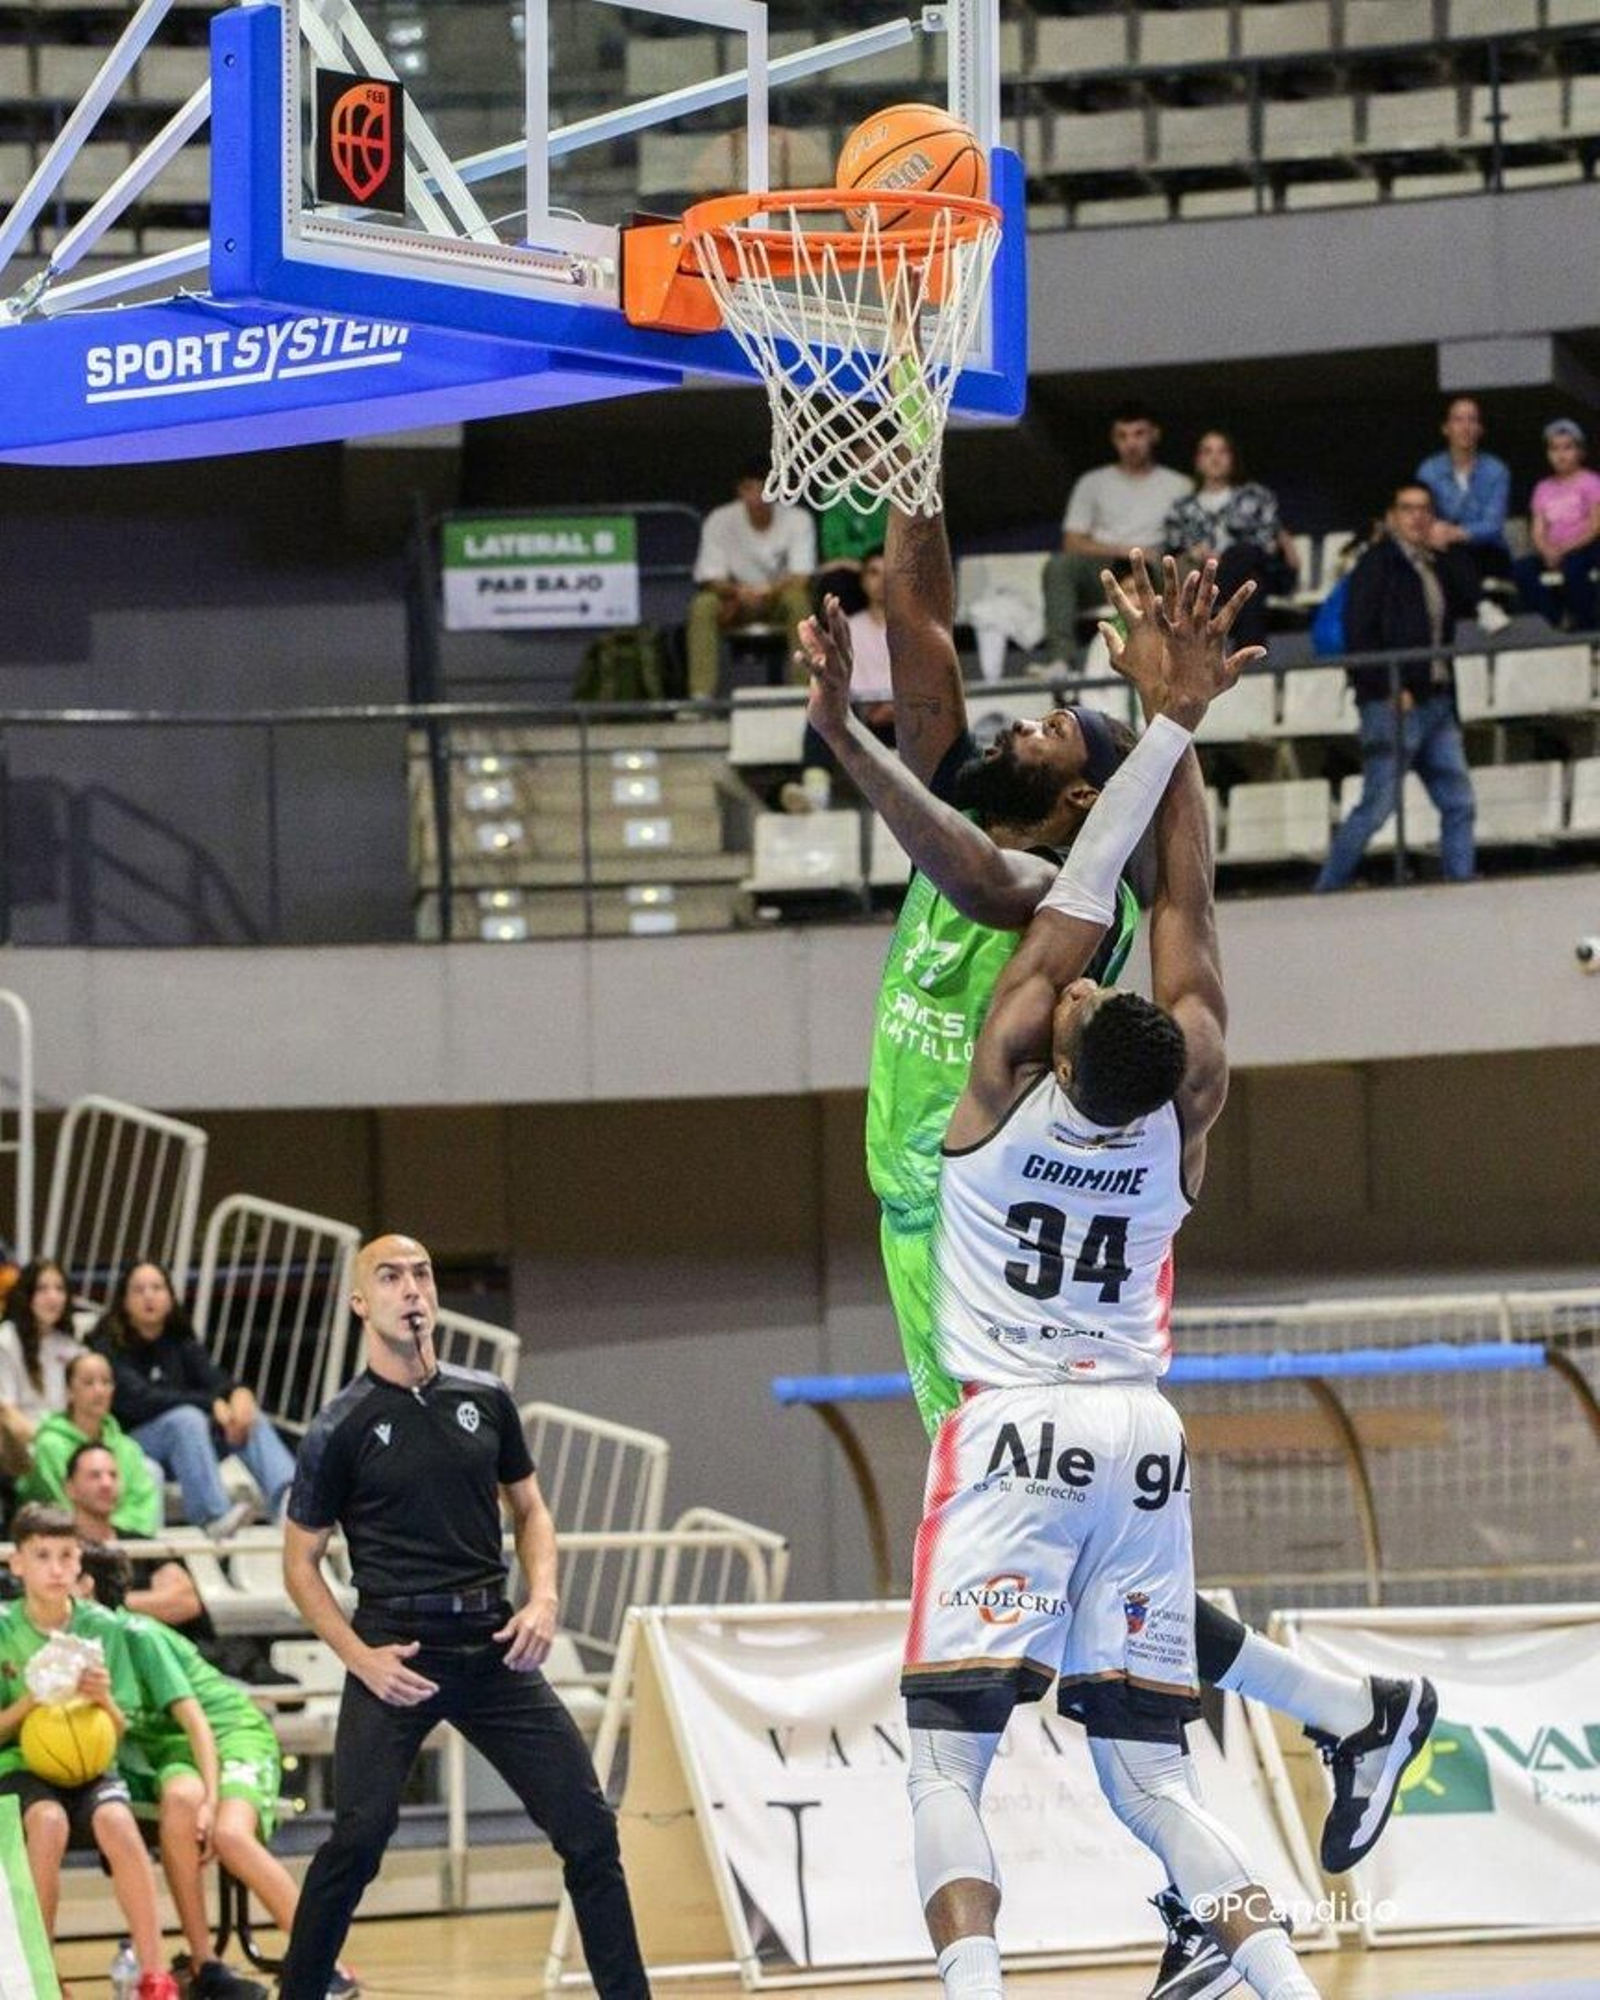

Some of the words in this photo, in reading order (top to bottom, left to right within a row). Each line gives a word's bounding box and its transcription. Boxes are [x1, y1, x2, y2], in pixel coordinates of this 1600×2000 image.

[366, 89, 385, 104] FEB
[463, 532, 590, 559] LATERAL
[535, 574, 603, 594] BAJO
[1003, 1200, 1134, 1304] 34
[1025, 1480, 1087, 1503] derecho
